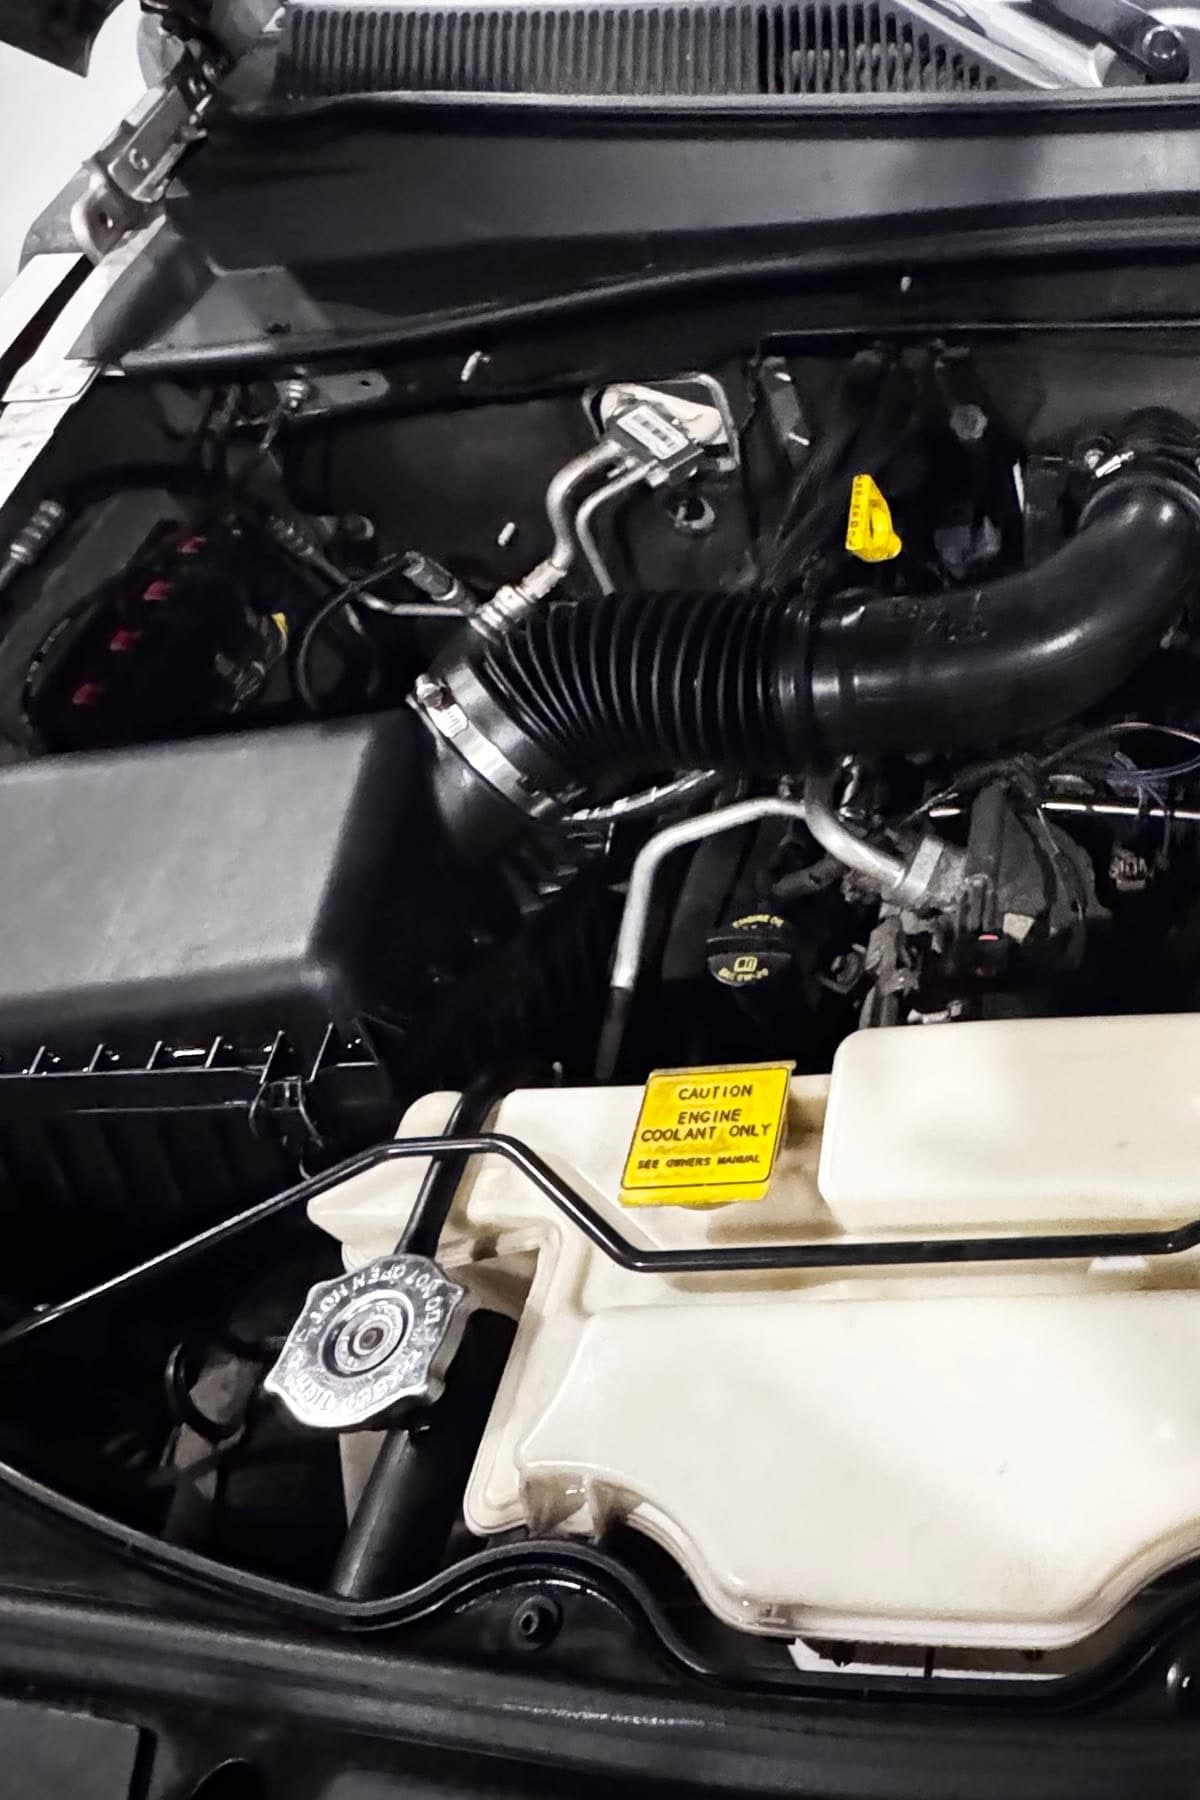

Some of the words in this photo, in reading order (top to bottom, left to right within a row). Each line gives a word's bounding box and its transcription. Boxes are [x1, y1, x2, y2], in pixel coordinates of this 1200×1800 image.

[678, 1084, 753, 1101] CAUTION
[677, 1108, 743, 1125] ENGINE
[641, 1126, 717, 1142] COOLANT
[729, 1123, 772, 1138] ONLY
[637, 1159, 660, 1170] SEE
[666, 1156, 711, 1168] OWNERS
[717, 1154, 761, 1165] MANUAL
